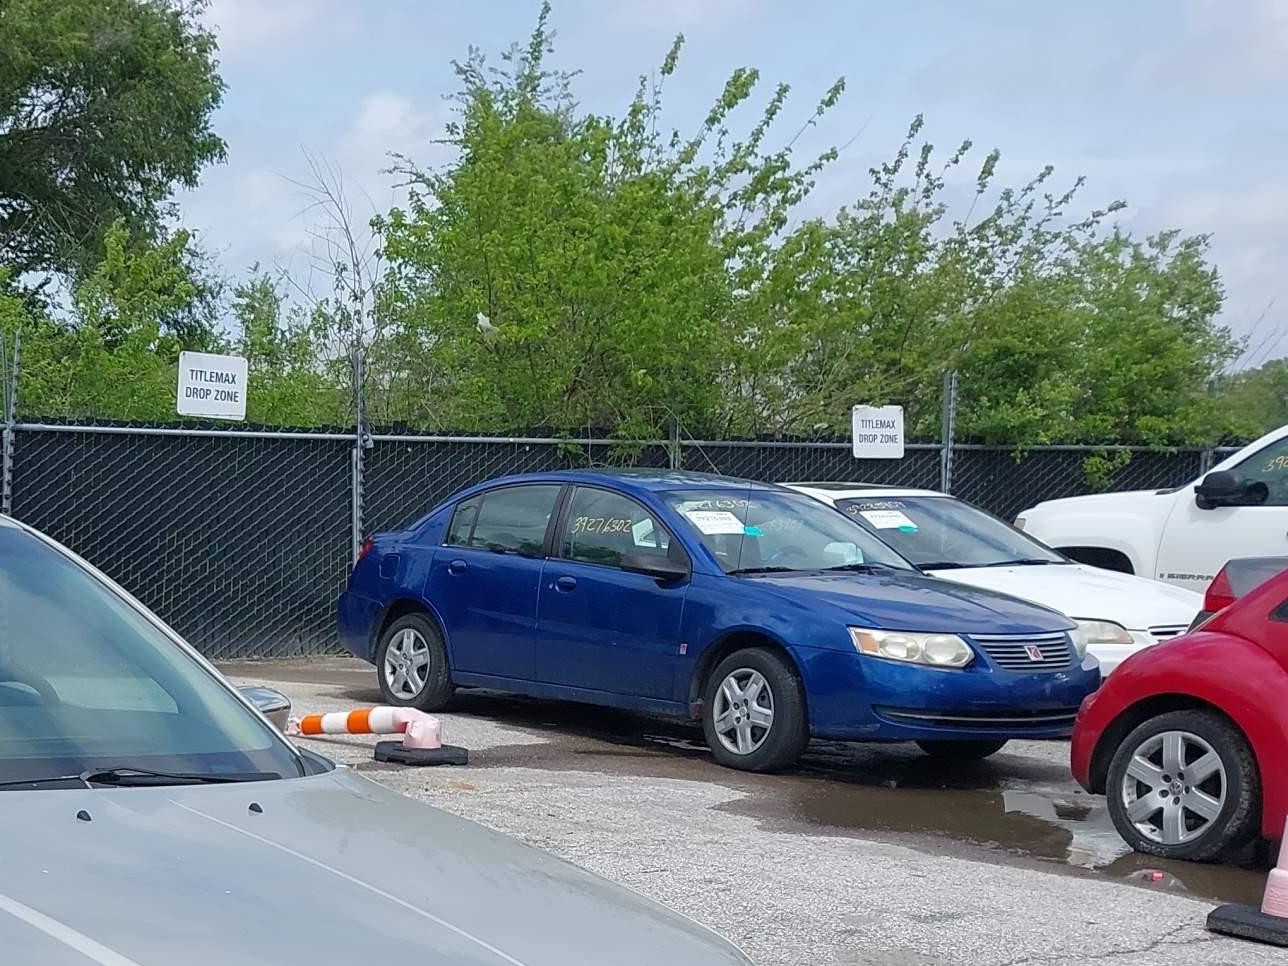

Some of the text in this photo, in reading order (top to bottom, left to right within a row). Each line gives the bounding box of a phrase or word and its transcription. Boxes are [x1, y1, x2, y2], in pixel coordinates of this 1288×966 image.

[190, 369, 236, 384] TITLEMAX
[185, 387, 239, 402] DROP ZONE
[861, 419, 896, 429] TITLEMAX
[859, 434, 899, 443] DROP ZONE
[572, 516, 631, 534] 39276302
